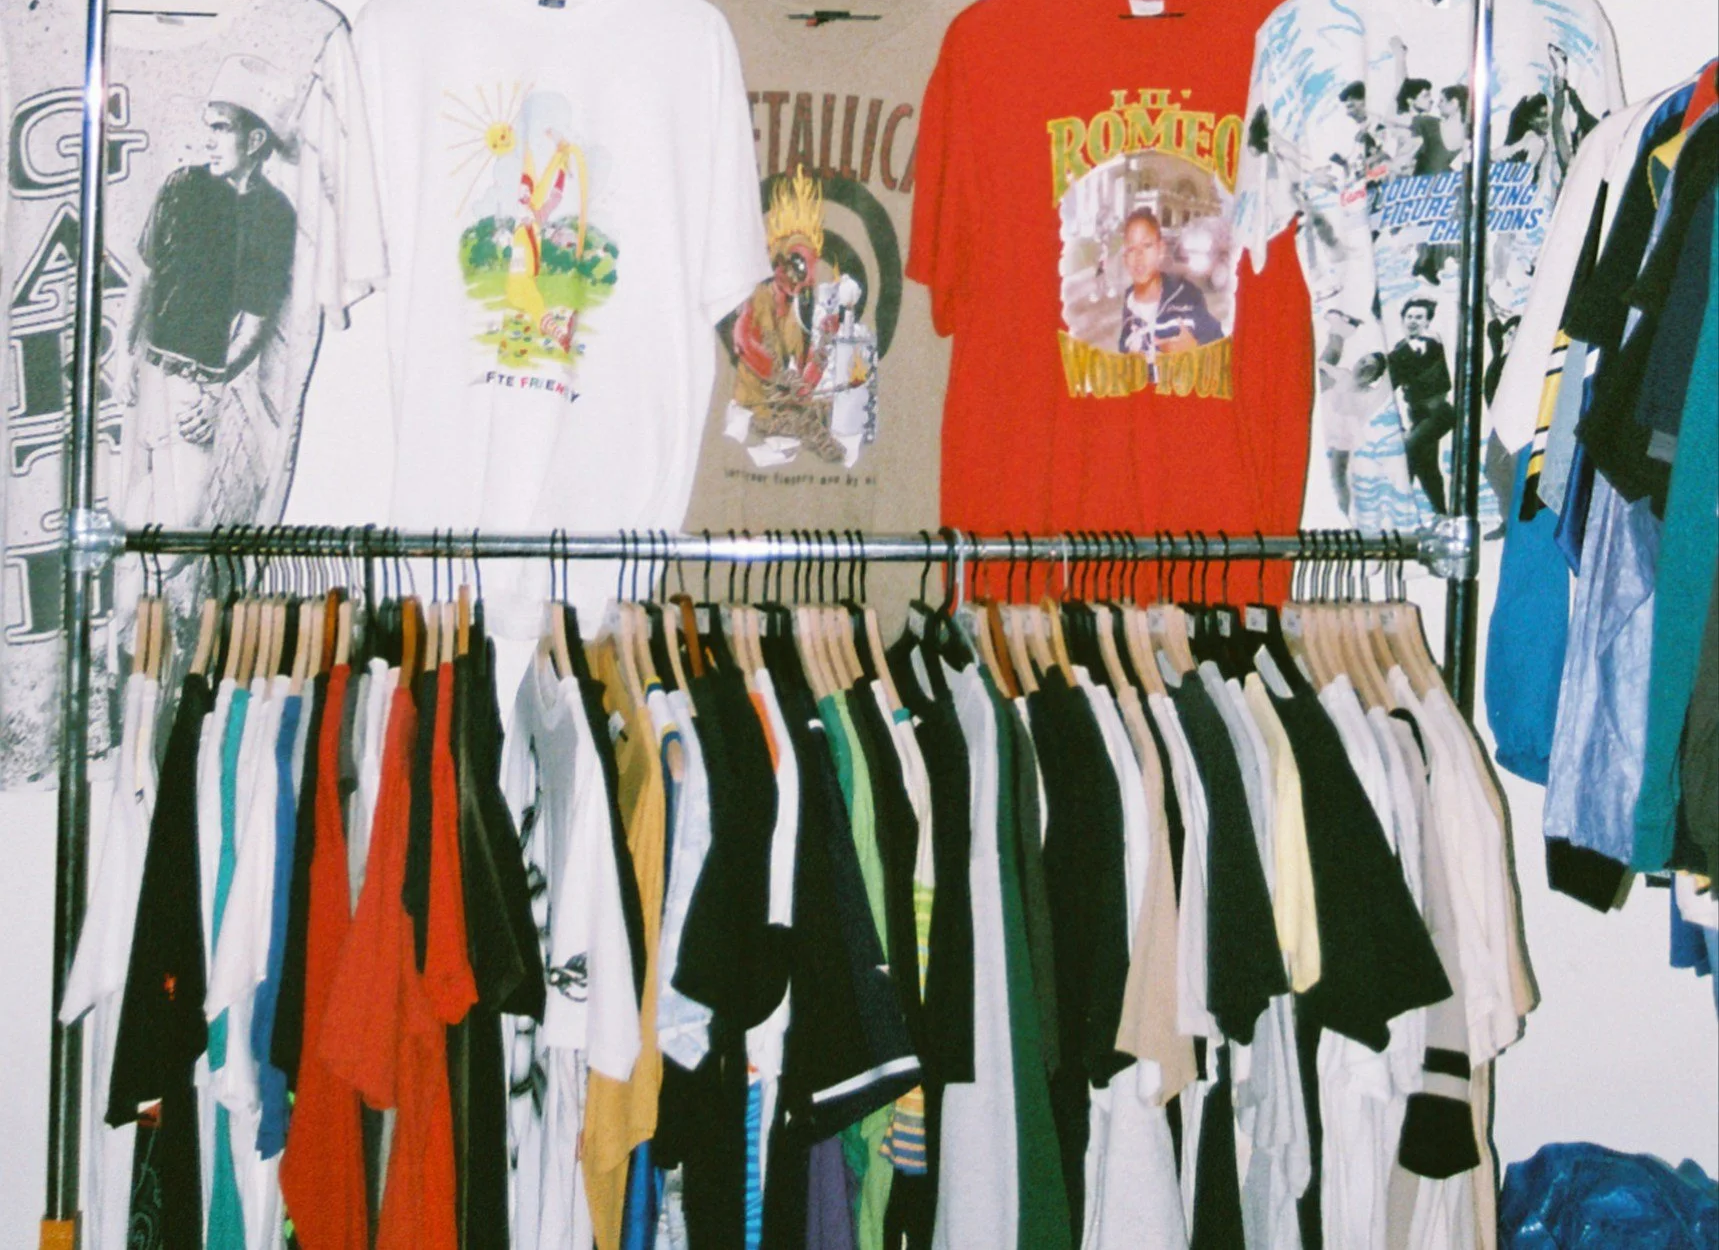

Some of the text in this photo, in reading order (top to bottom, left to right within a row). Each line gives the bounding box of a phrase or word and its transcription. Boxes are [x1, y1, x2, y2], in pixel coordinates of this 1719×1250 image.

[747, 90, 916, 193] TALLIC
[1047, 109, 1246, 208] ROMEO
[1380, 195, 1458, 227] FIGURE
[1433, 170, 1462, 198] OF
[1487, 161, 1532, 184] RLD
[1154, 336, 1233, 400] TOUR
